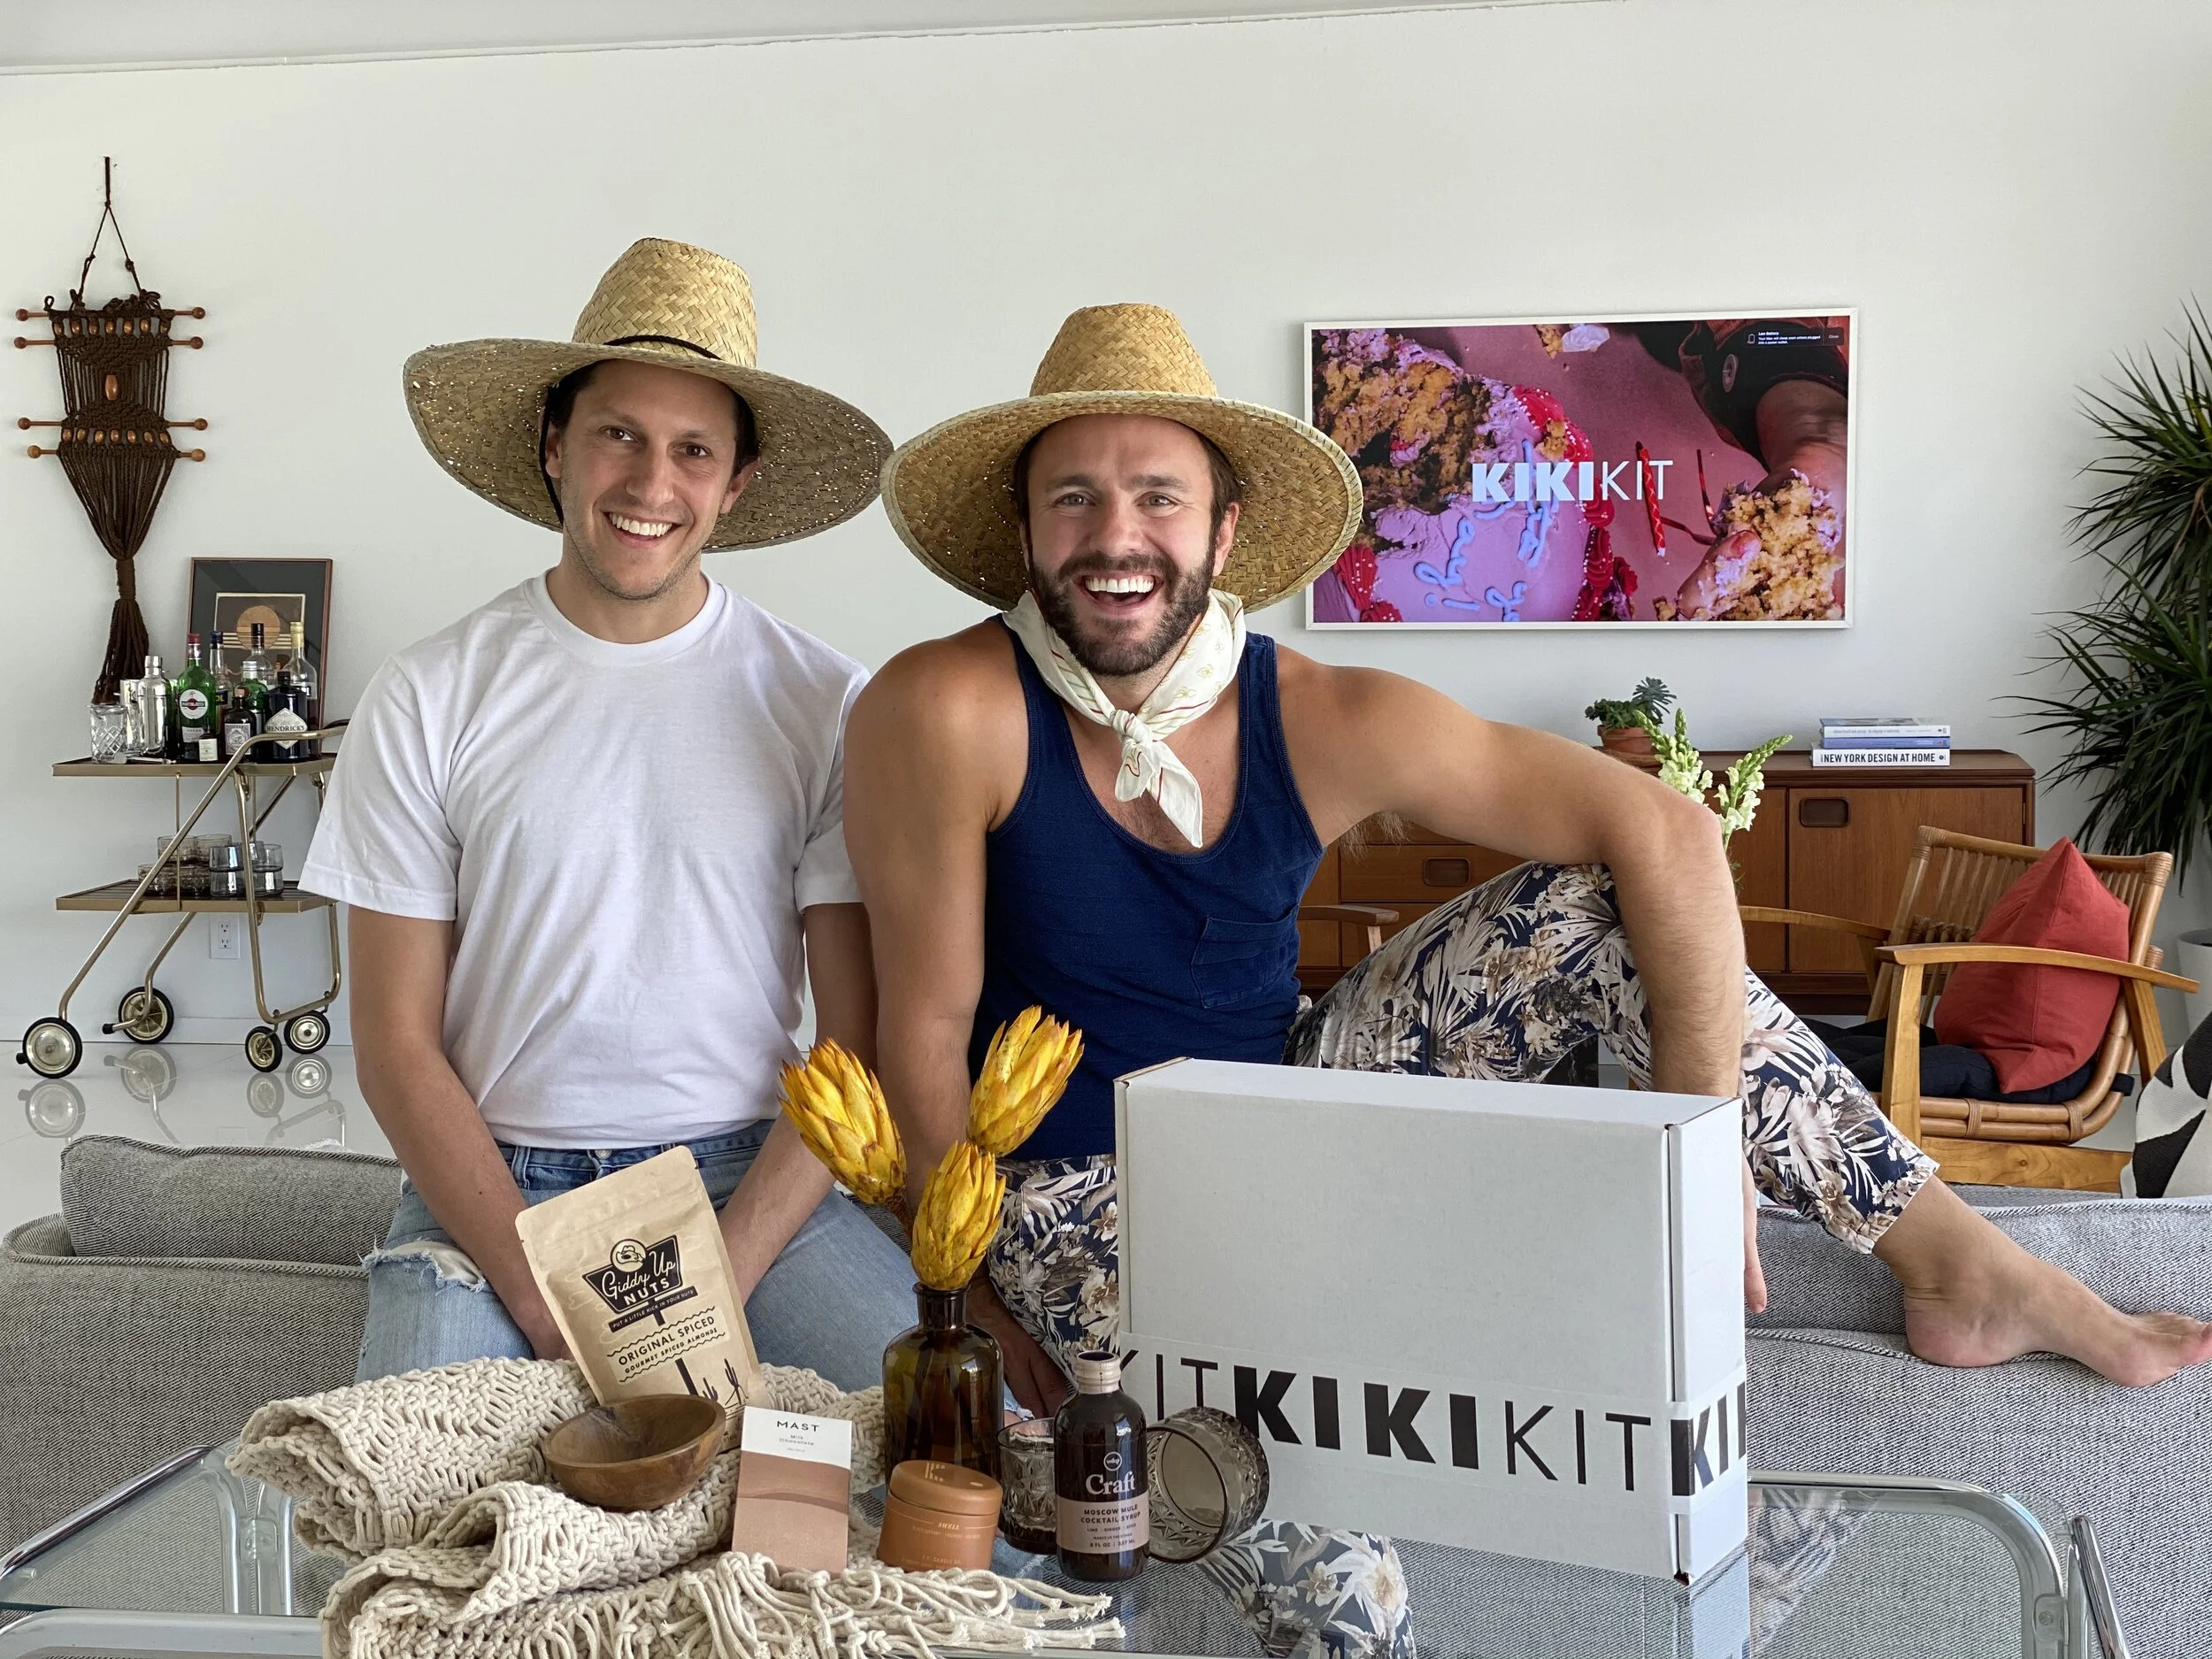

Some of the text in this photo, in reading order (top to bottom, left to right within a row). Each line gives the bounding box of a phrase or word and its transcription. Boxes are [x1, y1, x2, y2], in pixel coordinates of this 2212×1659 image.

[1824, 754, 1843, 764] NEW
[1844, 754, 1866, 763] YORK
[1868, 753, 1898, 763] DESIGN
[1900, 753, 1909, 763] AT
[1912, 753, 1936, 762] HOME
[602, 1250, 676, 1300] Giddy Up
[623, 1278, 670, 1306] NUTS
[628, 1310, 646, 1321] LITTLE
[646, 1304, 659, 1313] KICK
[666, 1294, 680, 1304] YOUR
[680, 1289, 695, 1298] NUTS
[618, 1316, 715, 1365] ORIGINAL SPICED
[625, 1327, 718, 1373] GOURMET SPICED ALMONDS
[777, 1420, 819, 1432] MAST
[1086, 1471, 1136, 1495] Craft
[1121, 1504, 1138, 1513] MULE
[1121, 1511, 1141, 1522] SYRUP
[938, 1522, 960, 1531] SWELL
